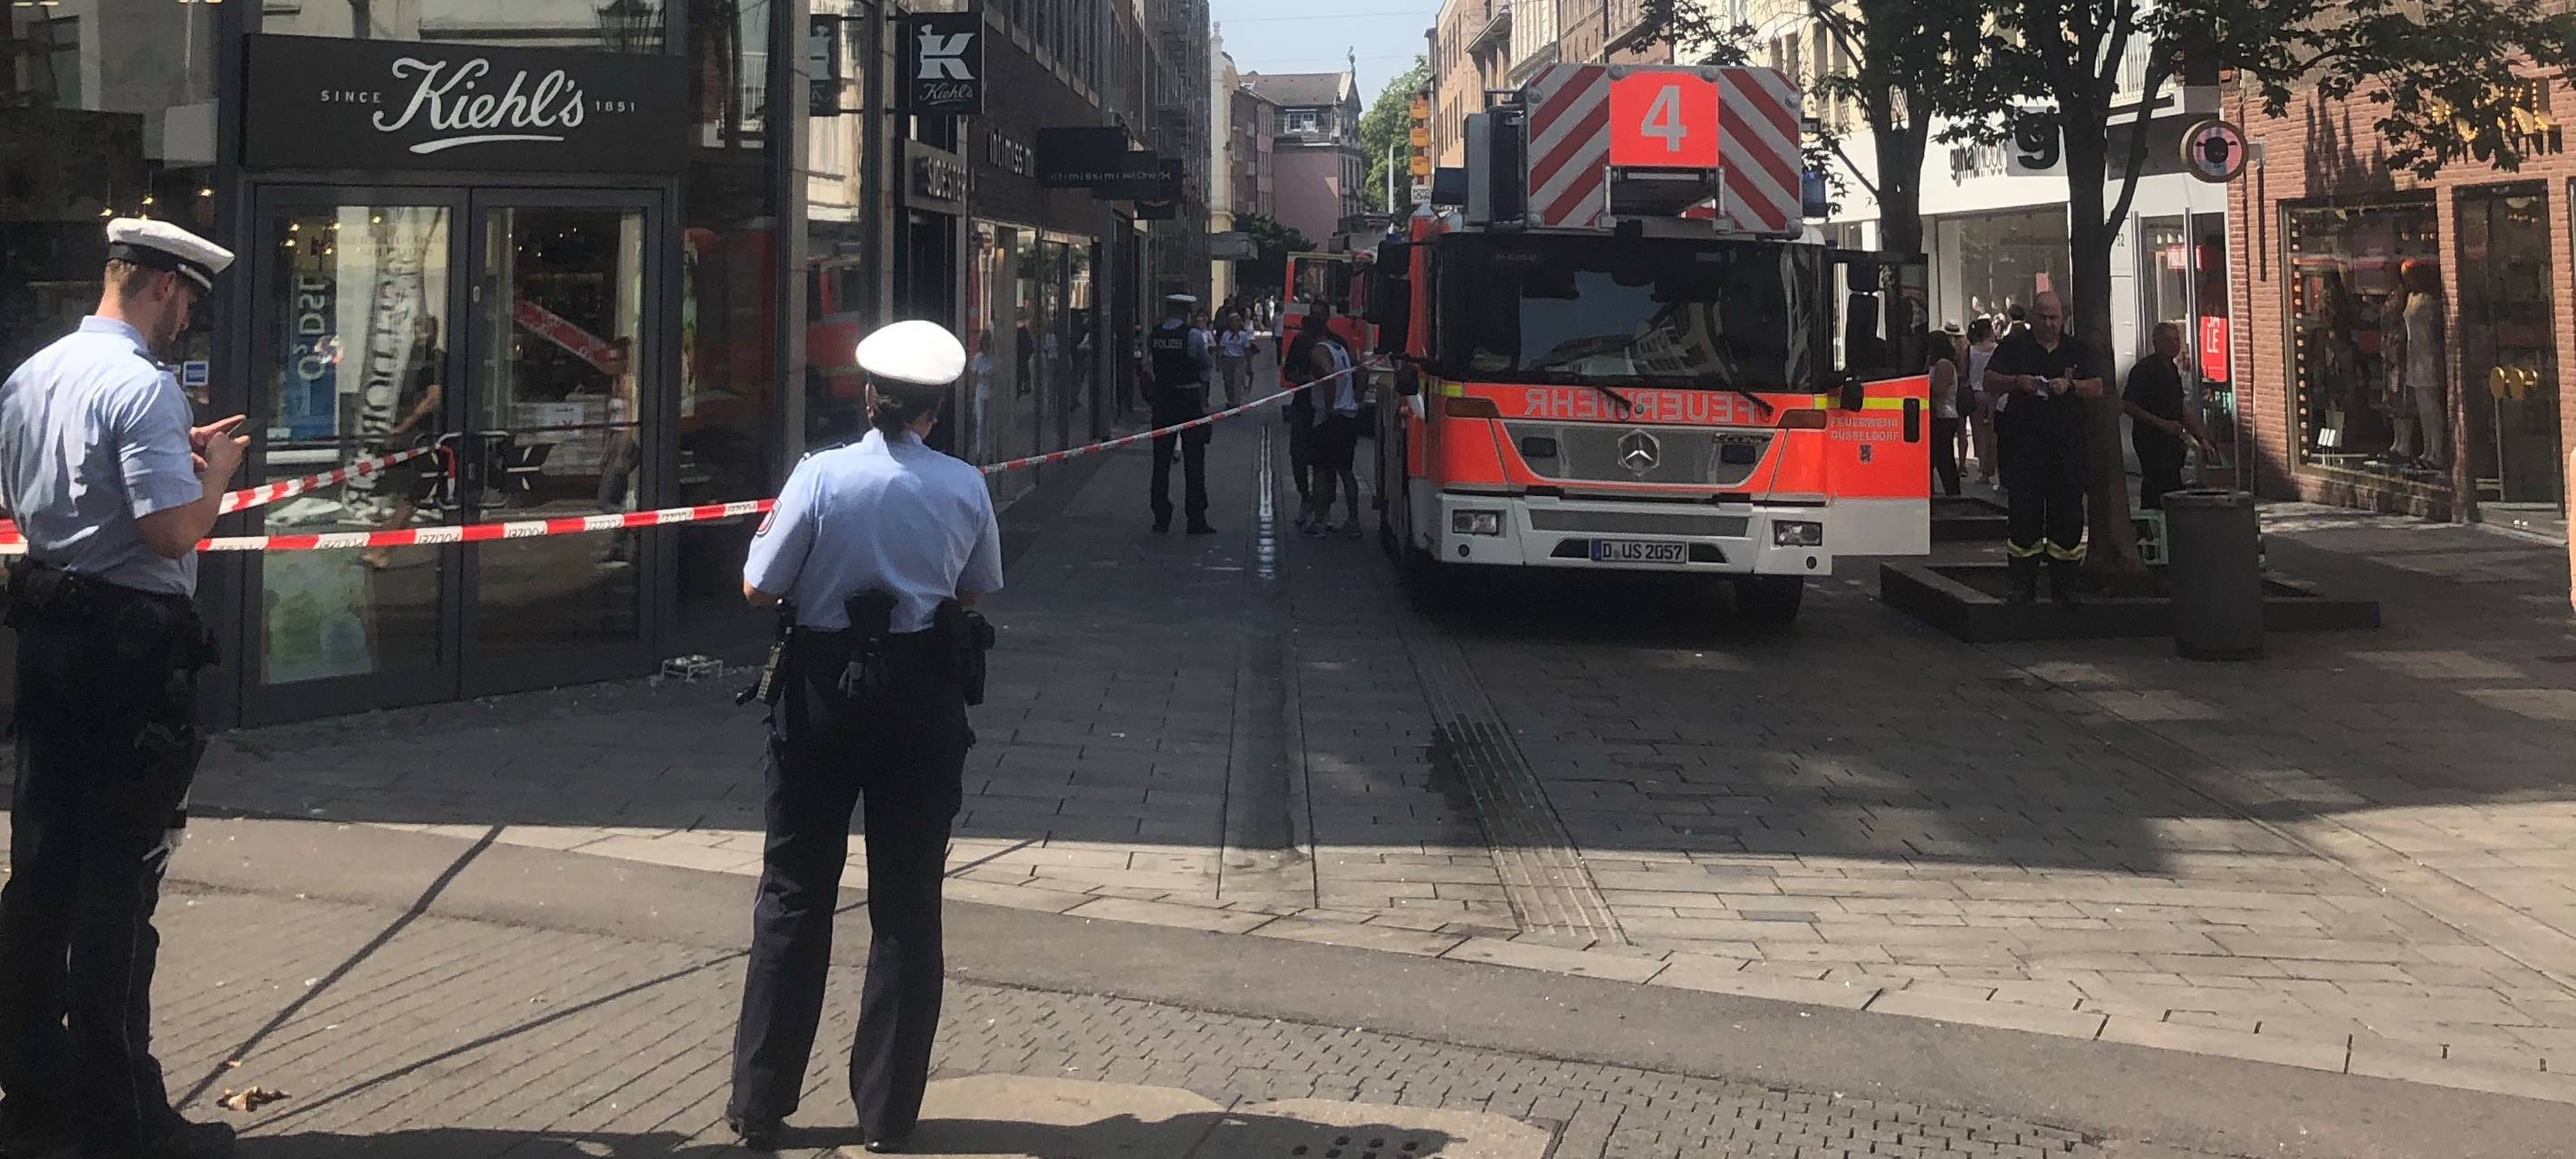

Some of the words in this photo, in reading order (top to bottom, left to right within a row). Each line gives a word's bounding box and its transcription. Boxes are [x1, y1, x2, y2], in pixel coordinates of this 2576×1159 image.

[321, 90, 382, 103] SINCE
[372, 56, 584, 132] Kiehl's
[596, 100, 636, 113] 1851
[918, 82, 974, 102] Kiehl's
[1640, 85, 1687, 152] 4
[1153, 339, 1183, 349] POLIZEI
[1830, 417, 1898, 427] FEUERWEHR
[1830, 428, 1899, 441] DÜSSELDORF
[418, 532, 460, 544] POLIZEI
[507, 527, 545, 538] POLIZEI
[1602, 543, 1612, 559] D
[1621, 543, 1642, 560] US
[1645, 544, 1683, 560] 2057
